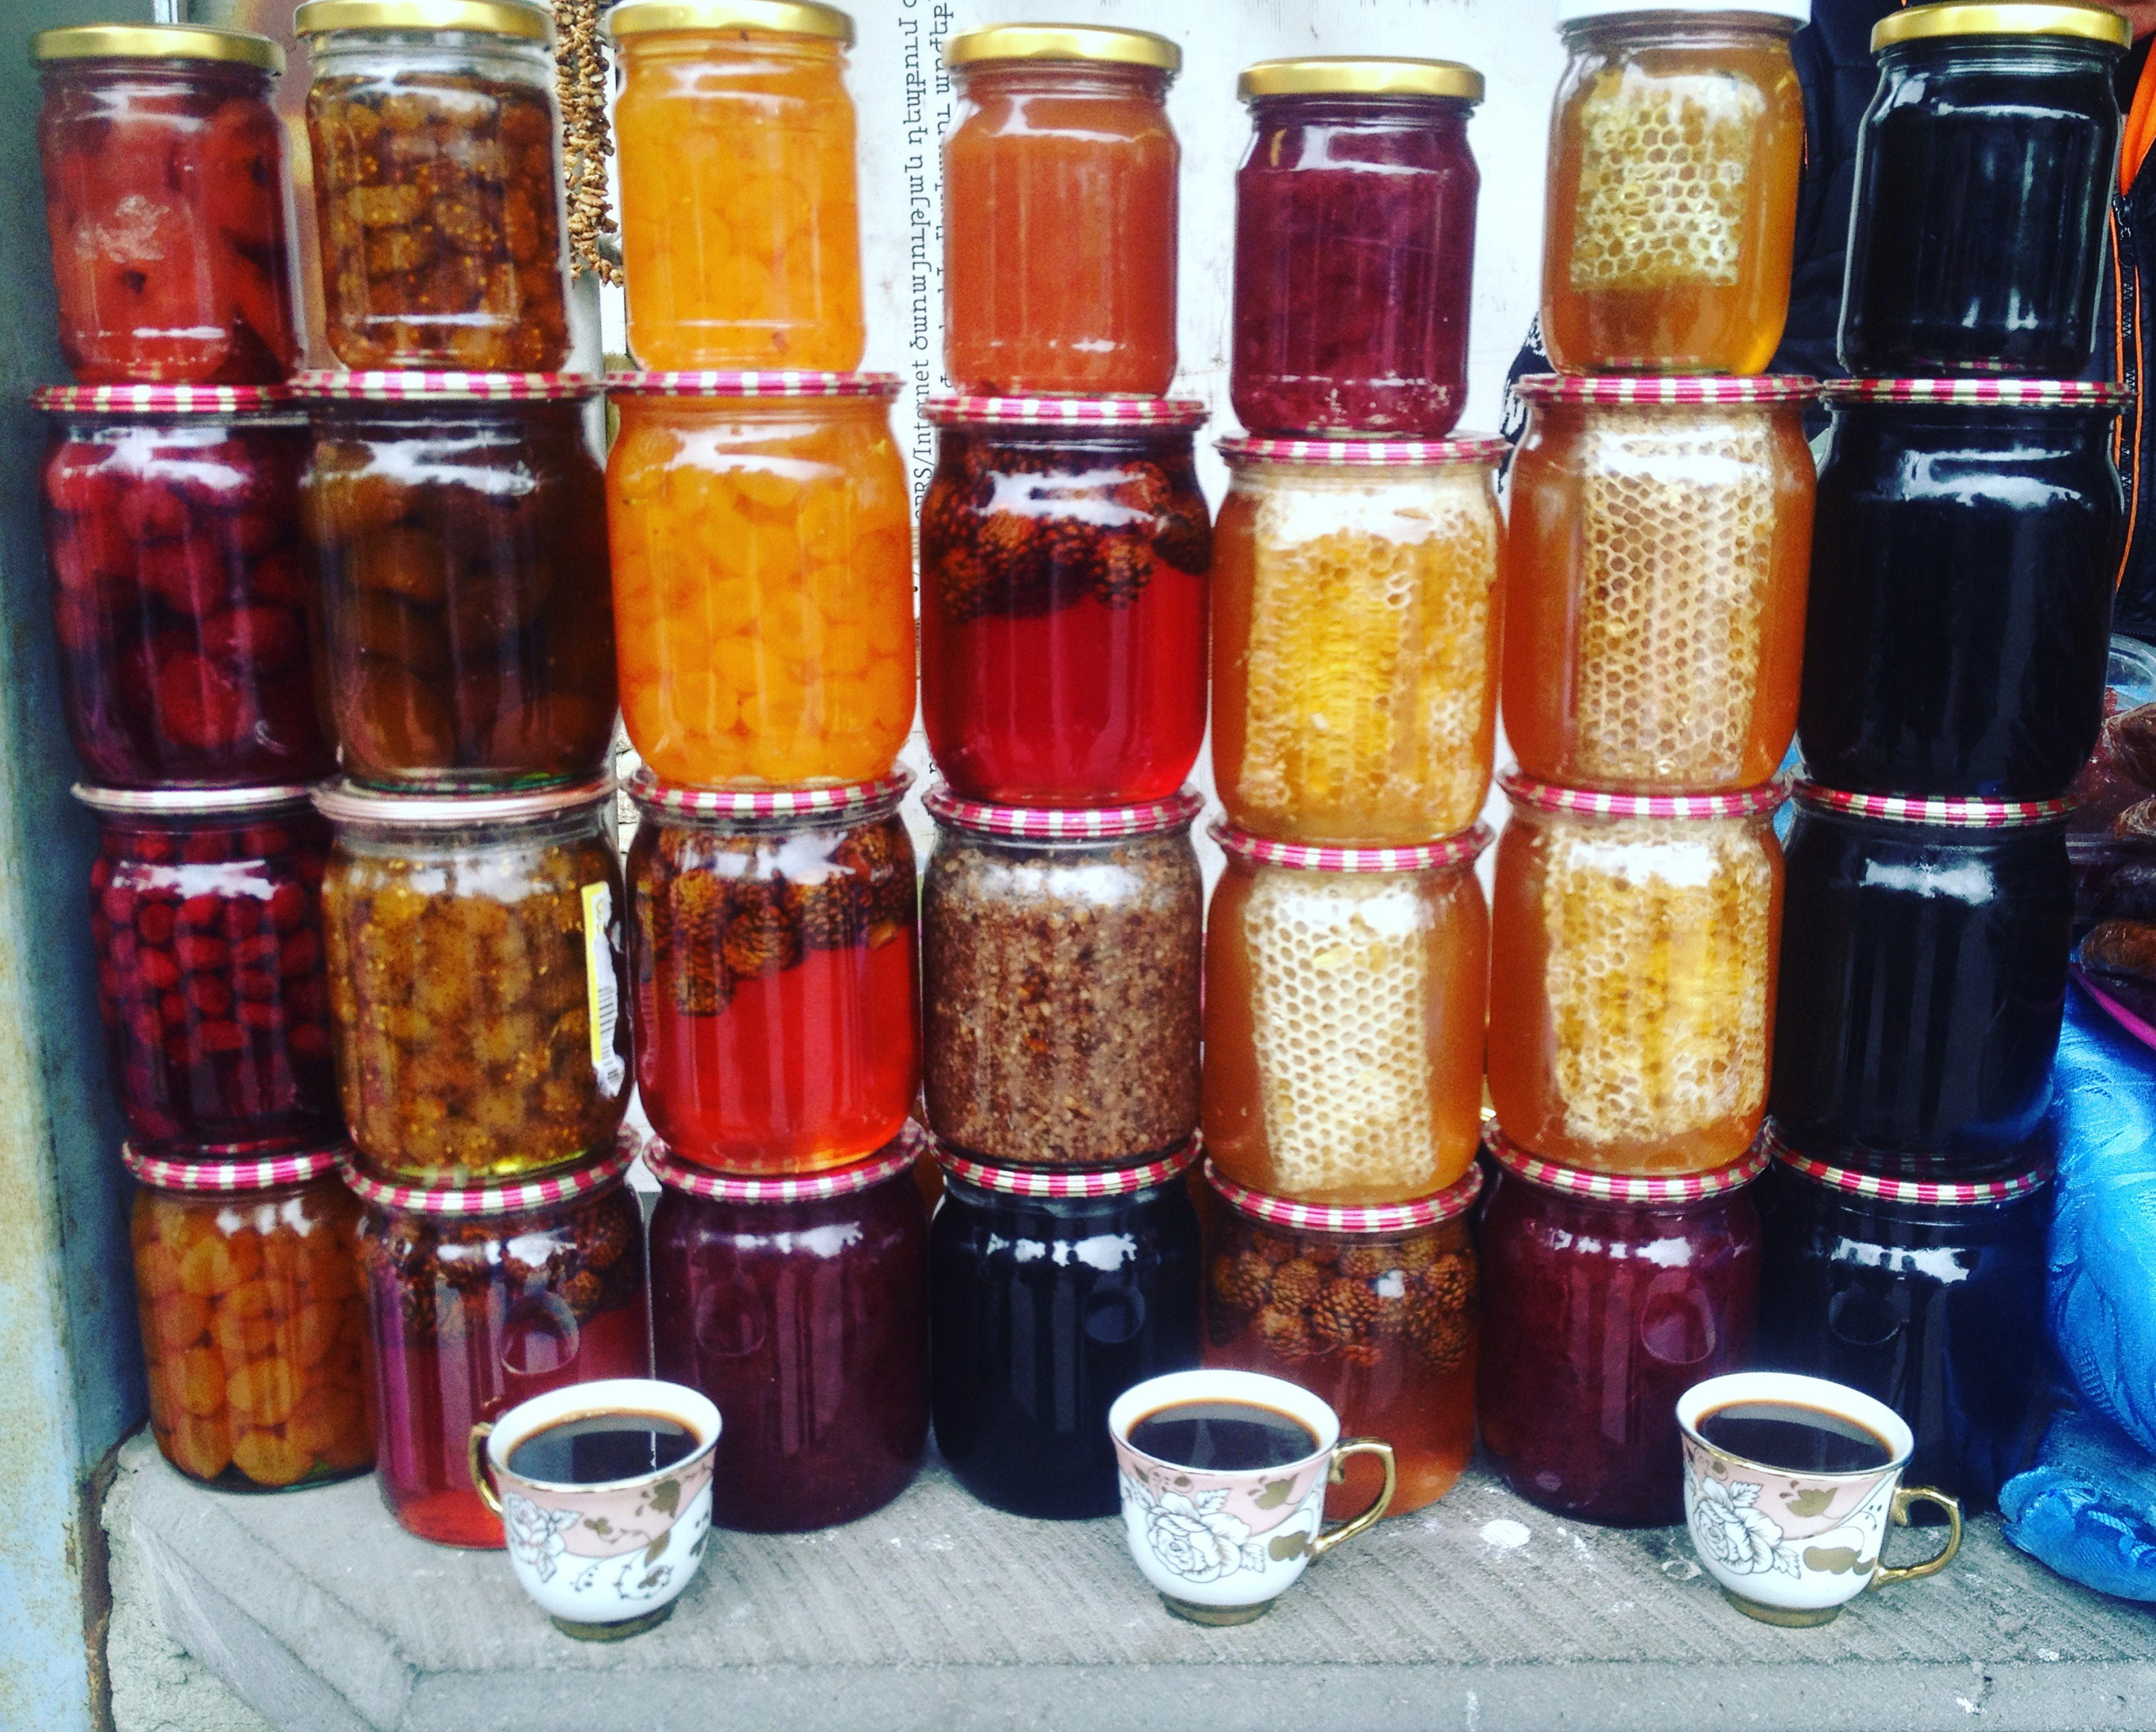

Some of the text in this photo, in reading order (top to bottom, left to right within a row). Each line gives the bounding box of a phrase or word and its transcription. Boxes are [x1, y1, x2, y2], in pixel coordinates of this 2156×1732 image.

[899, 17, 927, 144] դեպքում
[905, 154, 931, 350] ծառայության
[910, 360, 935, 520] PRS/Intrnet
